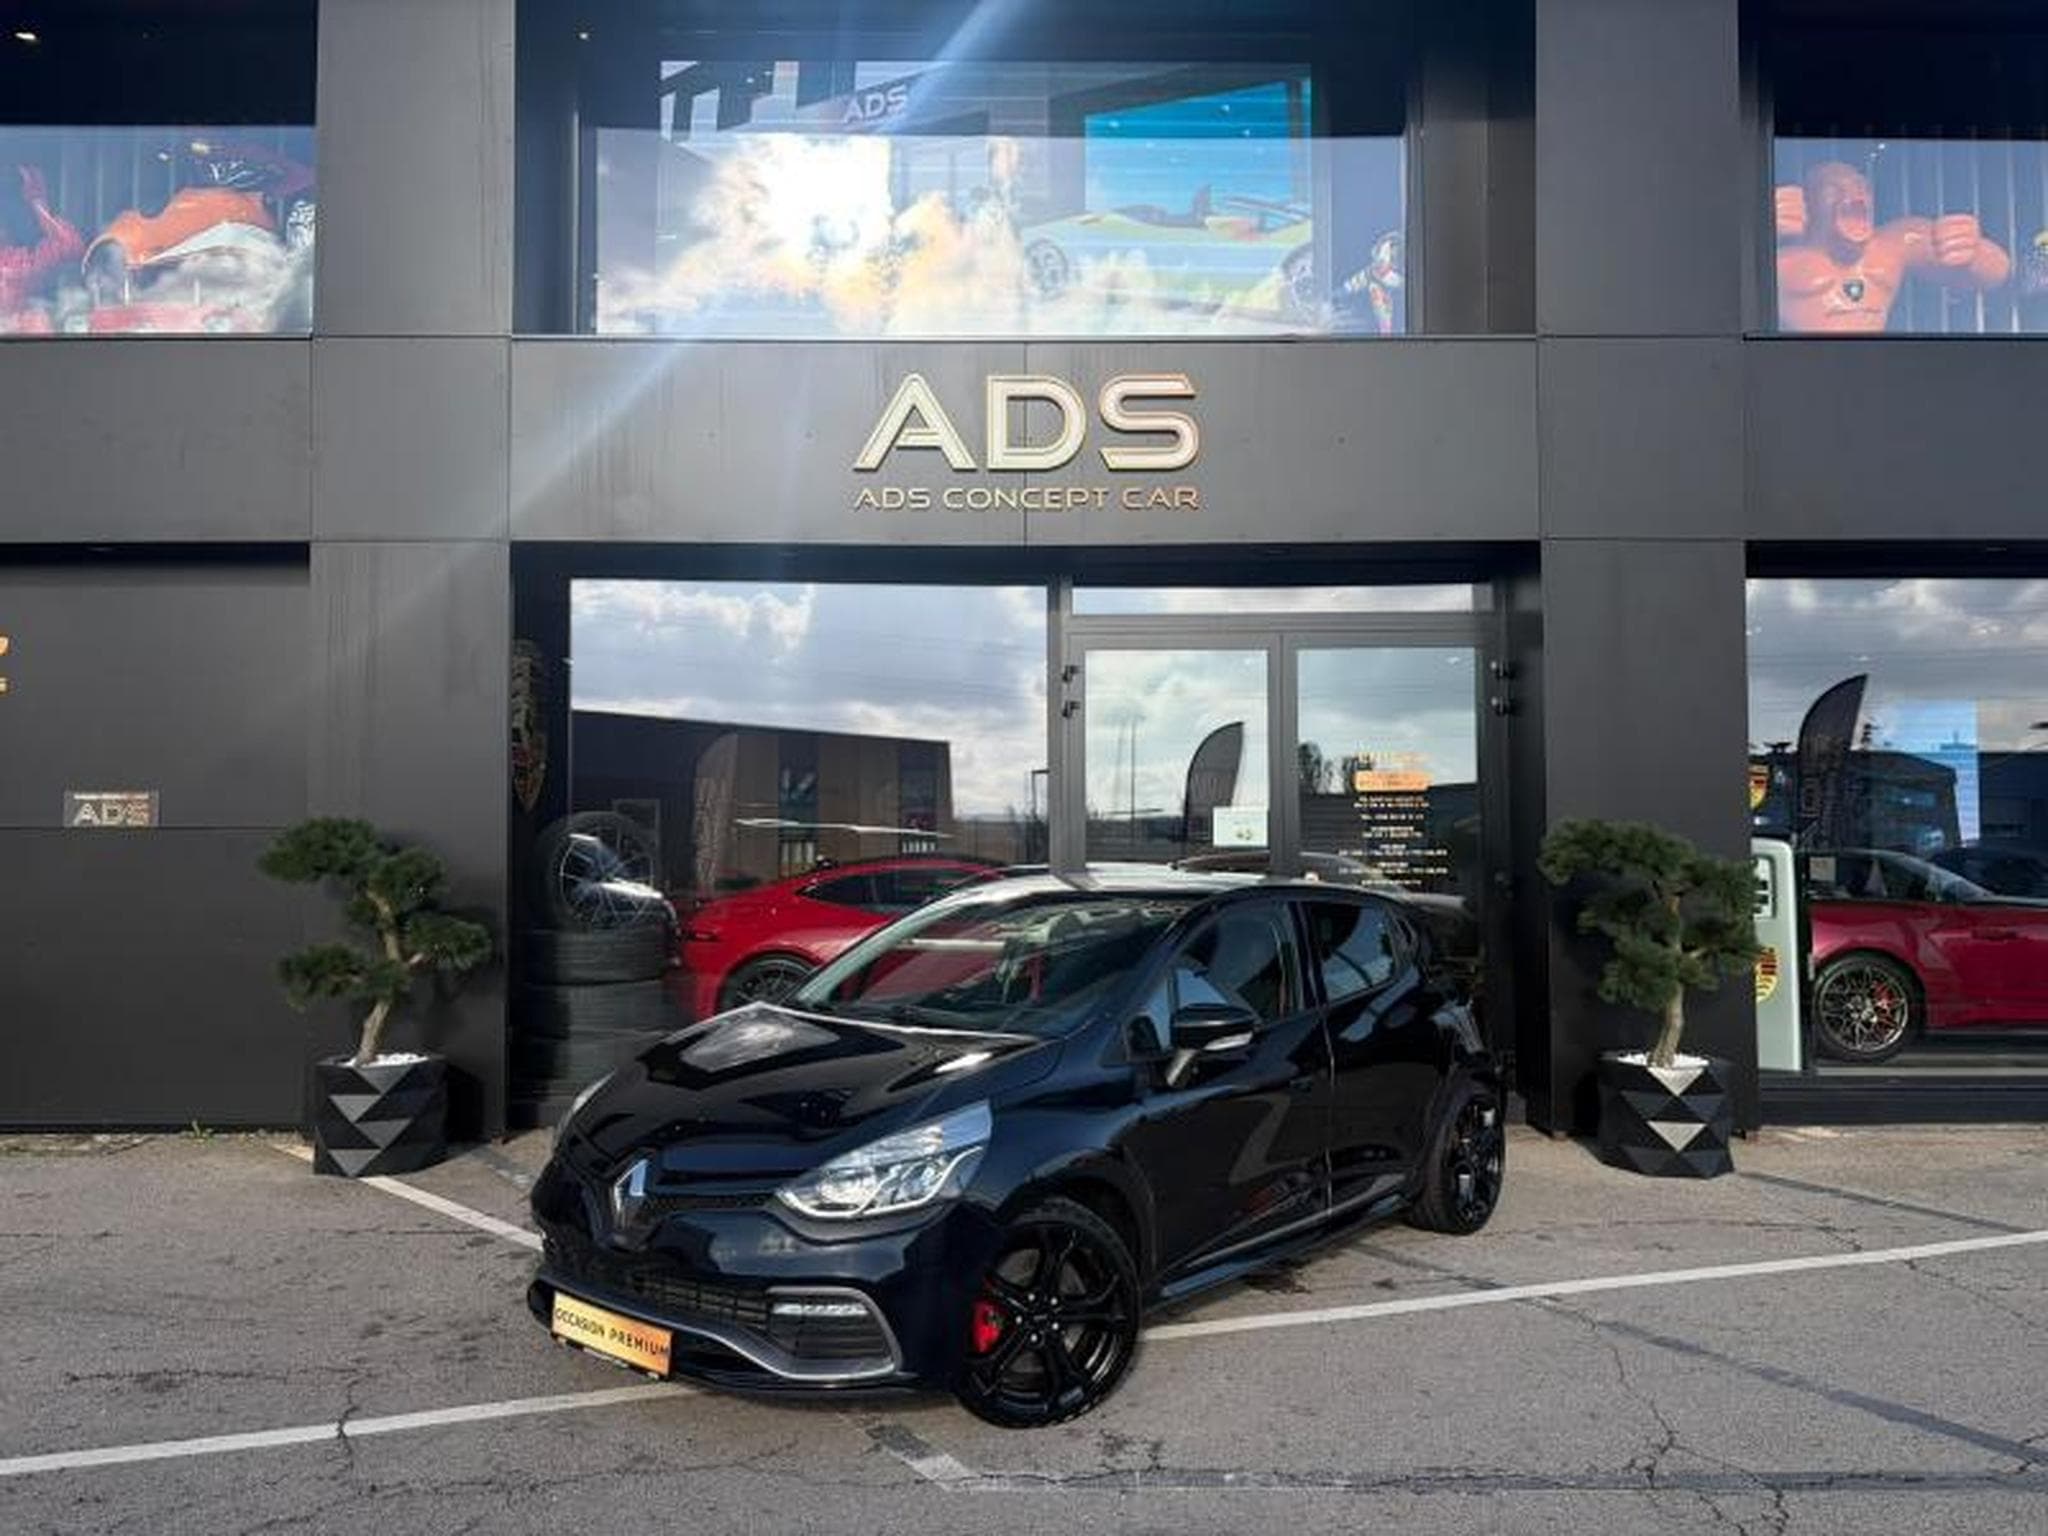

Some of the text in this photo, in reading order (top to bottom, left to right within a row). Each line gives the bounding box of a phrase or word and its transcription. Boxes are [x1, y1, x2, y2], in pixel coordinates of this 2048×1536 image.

[845, 85, 907, 123] ADS
[853, 372, 1200, 472] ADS
[854, 487, 1200, 509] ADS CONCEPT CAR
[73, 802, 150, 826] ADS
[555, 1307, 669, 1355] OCCASION PREMIUM
